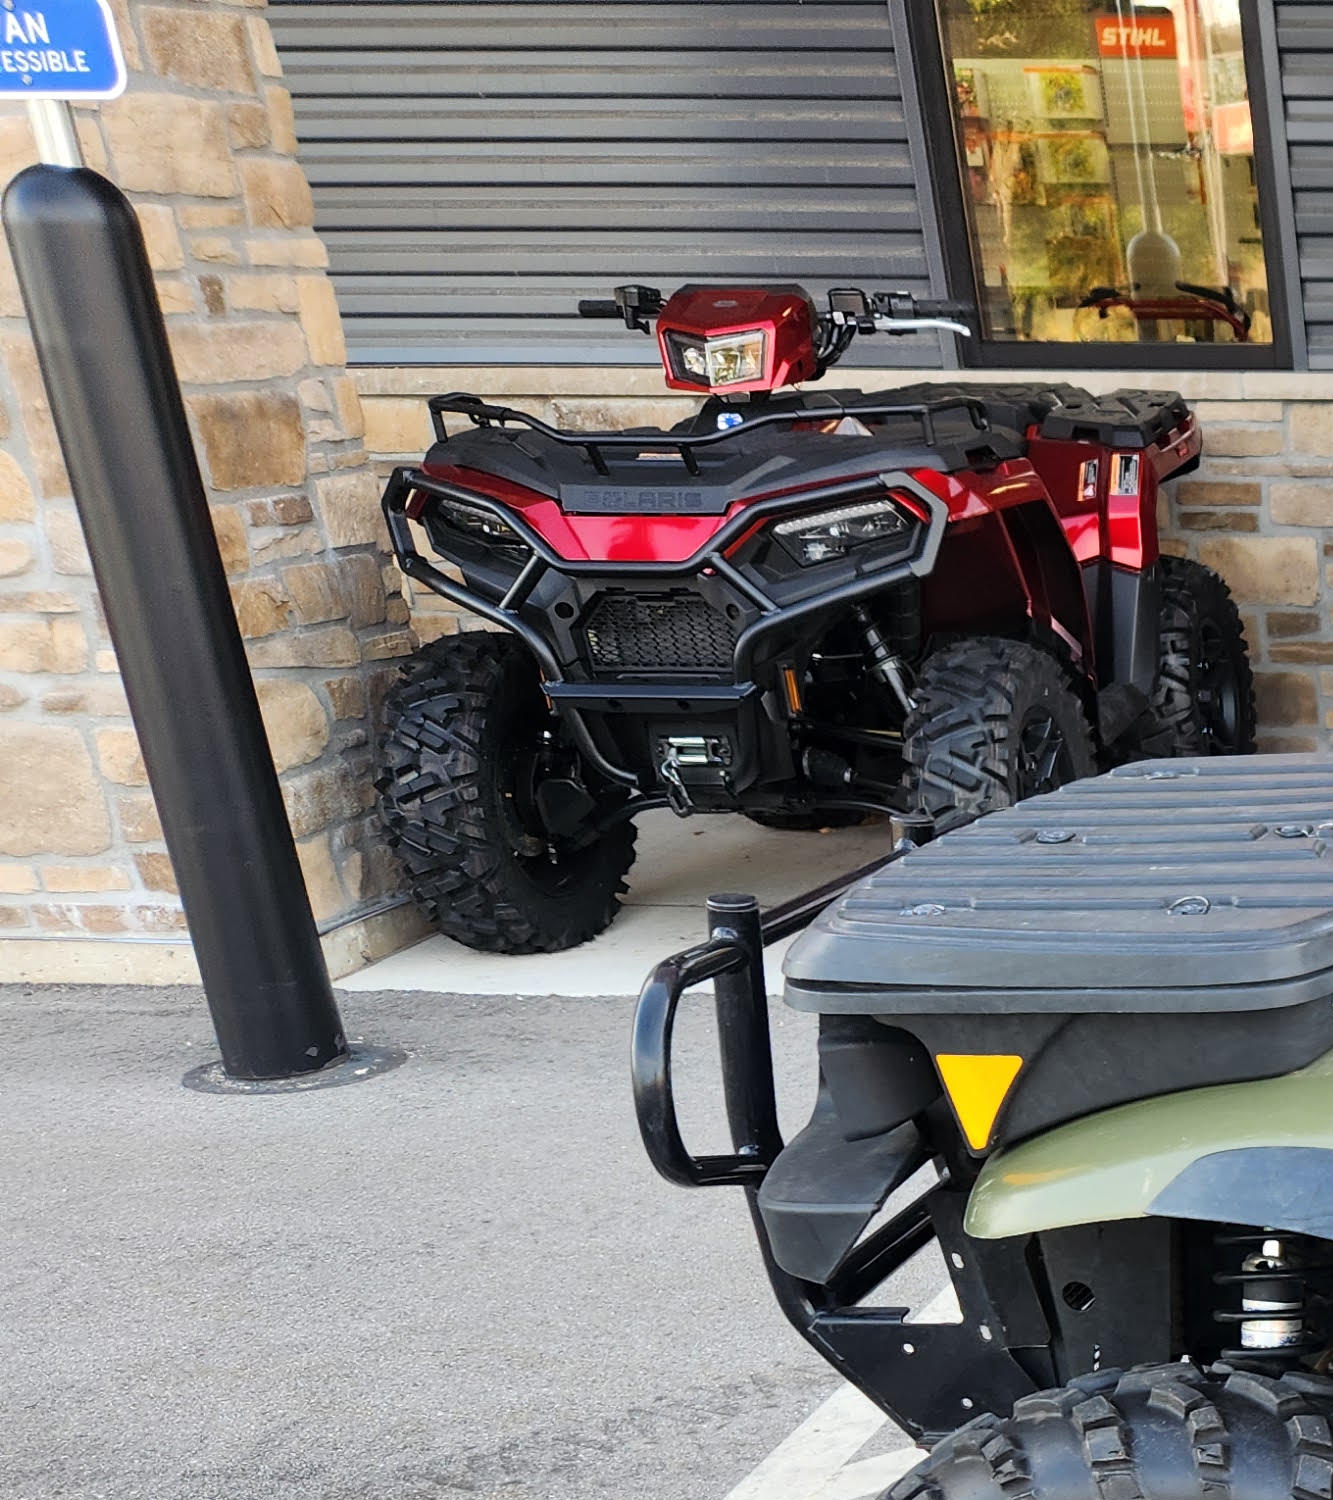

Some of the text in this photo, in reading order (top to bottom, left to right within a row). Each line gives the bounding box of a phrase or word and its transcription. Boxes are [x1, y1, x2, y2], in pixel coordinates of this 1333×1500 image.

[1101, 26, 1166, 47] STIHL
[0, 50, 91, 73] ESSIBLE
[583, 490, 703, 509] POLARIS
